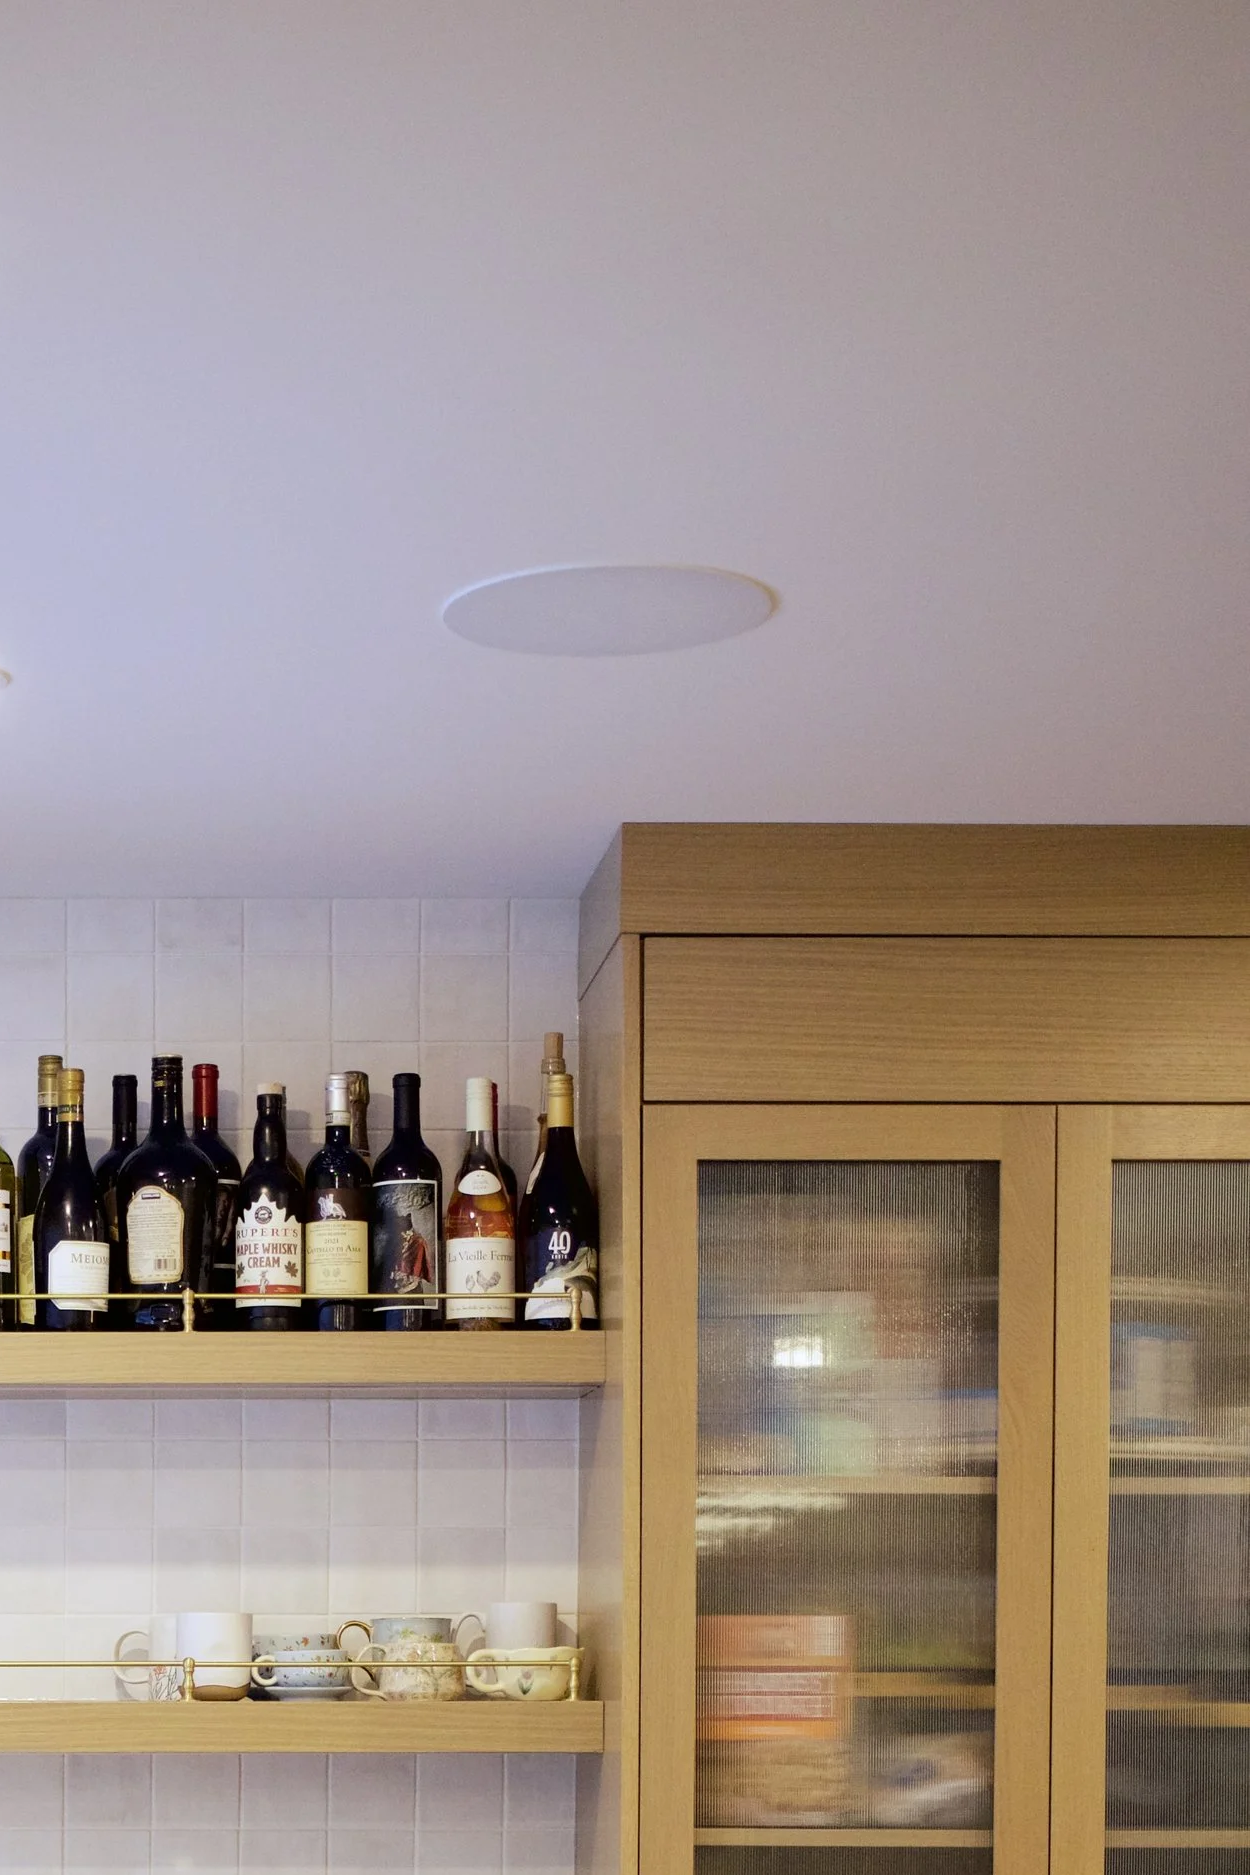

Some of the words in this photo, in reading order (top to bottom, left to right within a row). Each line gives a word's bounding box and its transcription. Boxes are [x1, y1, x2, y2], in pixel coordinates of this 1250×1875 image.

[236, 1228, 299, 1240] RUPERT'S
[548, 1231, 571, 1254] 40
[236, 1243, 259, 1256] MAPLE
[261, 1243, 298, 1255] WHISKY
[458, 1250, 488, 1261] Vieille
[71, 1253, 110, 1265] MEIOM
[247, 1257, 281, 1269] CREAM
